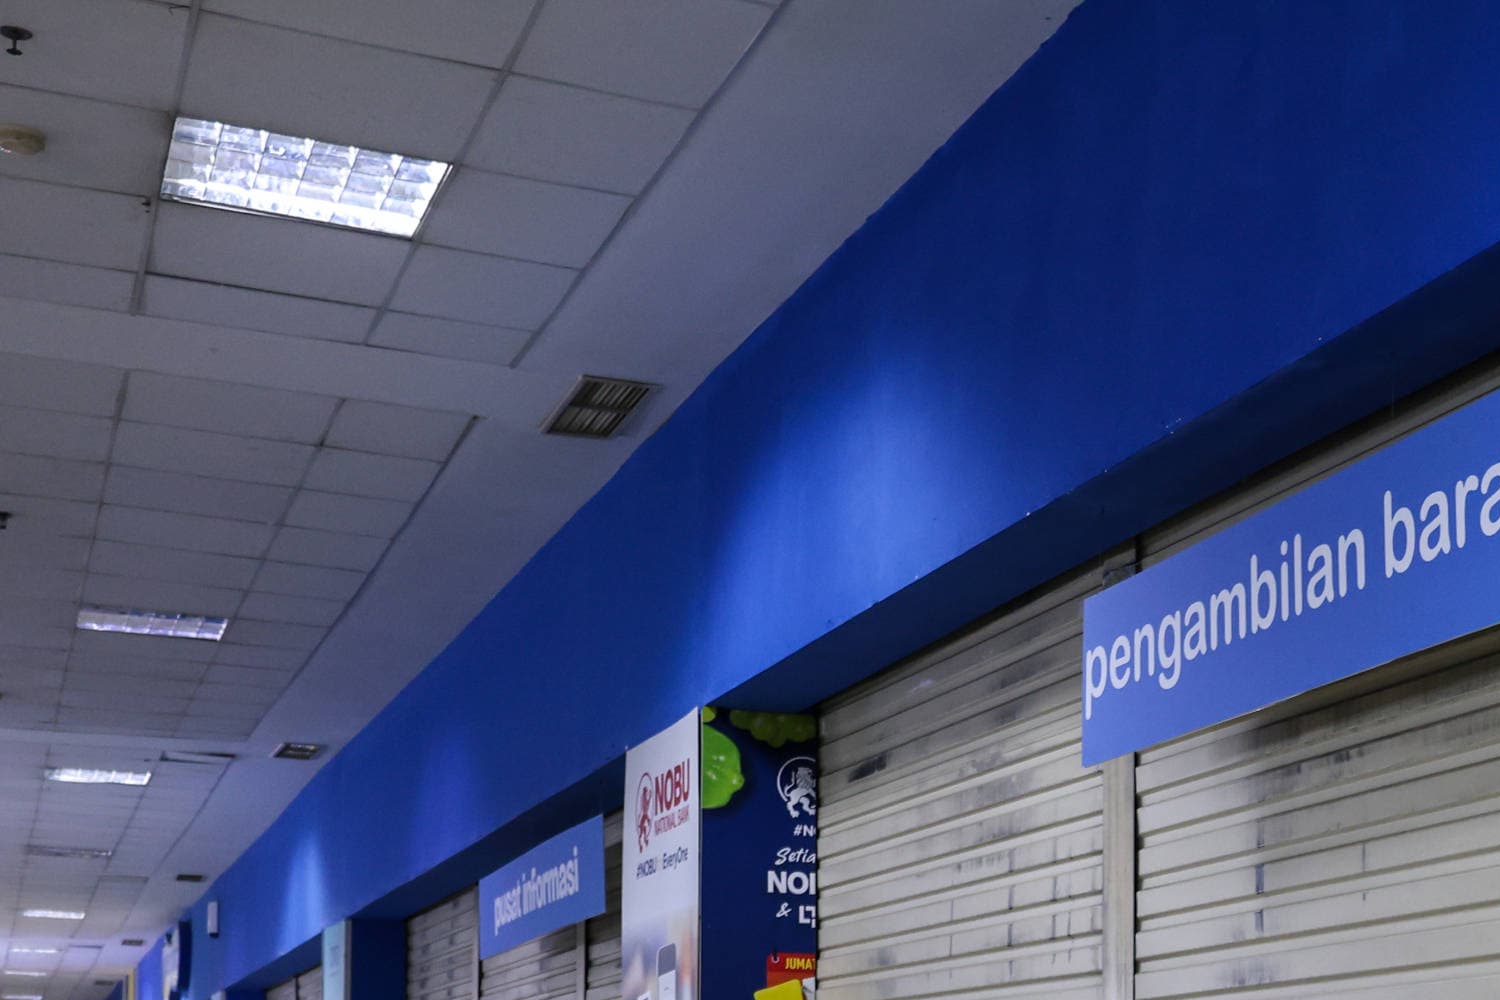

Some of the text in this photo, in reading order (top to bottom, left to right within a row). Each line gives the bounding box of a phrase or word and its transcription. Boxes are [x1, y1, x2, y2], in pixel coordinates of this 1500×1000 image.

[1083, 524, 1367, 721] pengambilan
[654, 757, 690, 816] NOBU
[494, 846, 579, 937] pusat informasi
